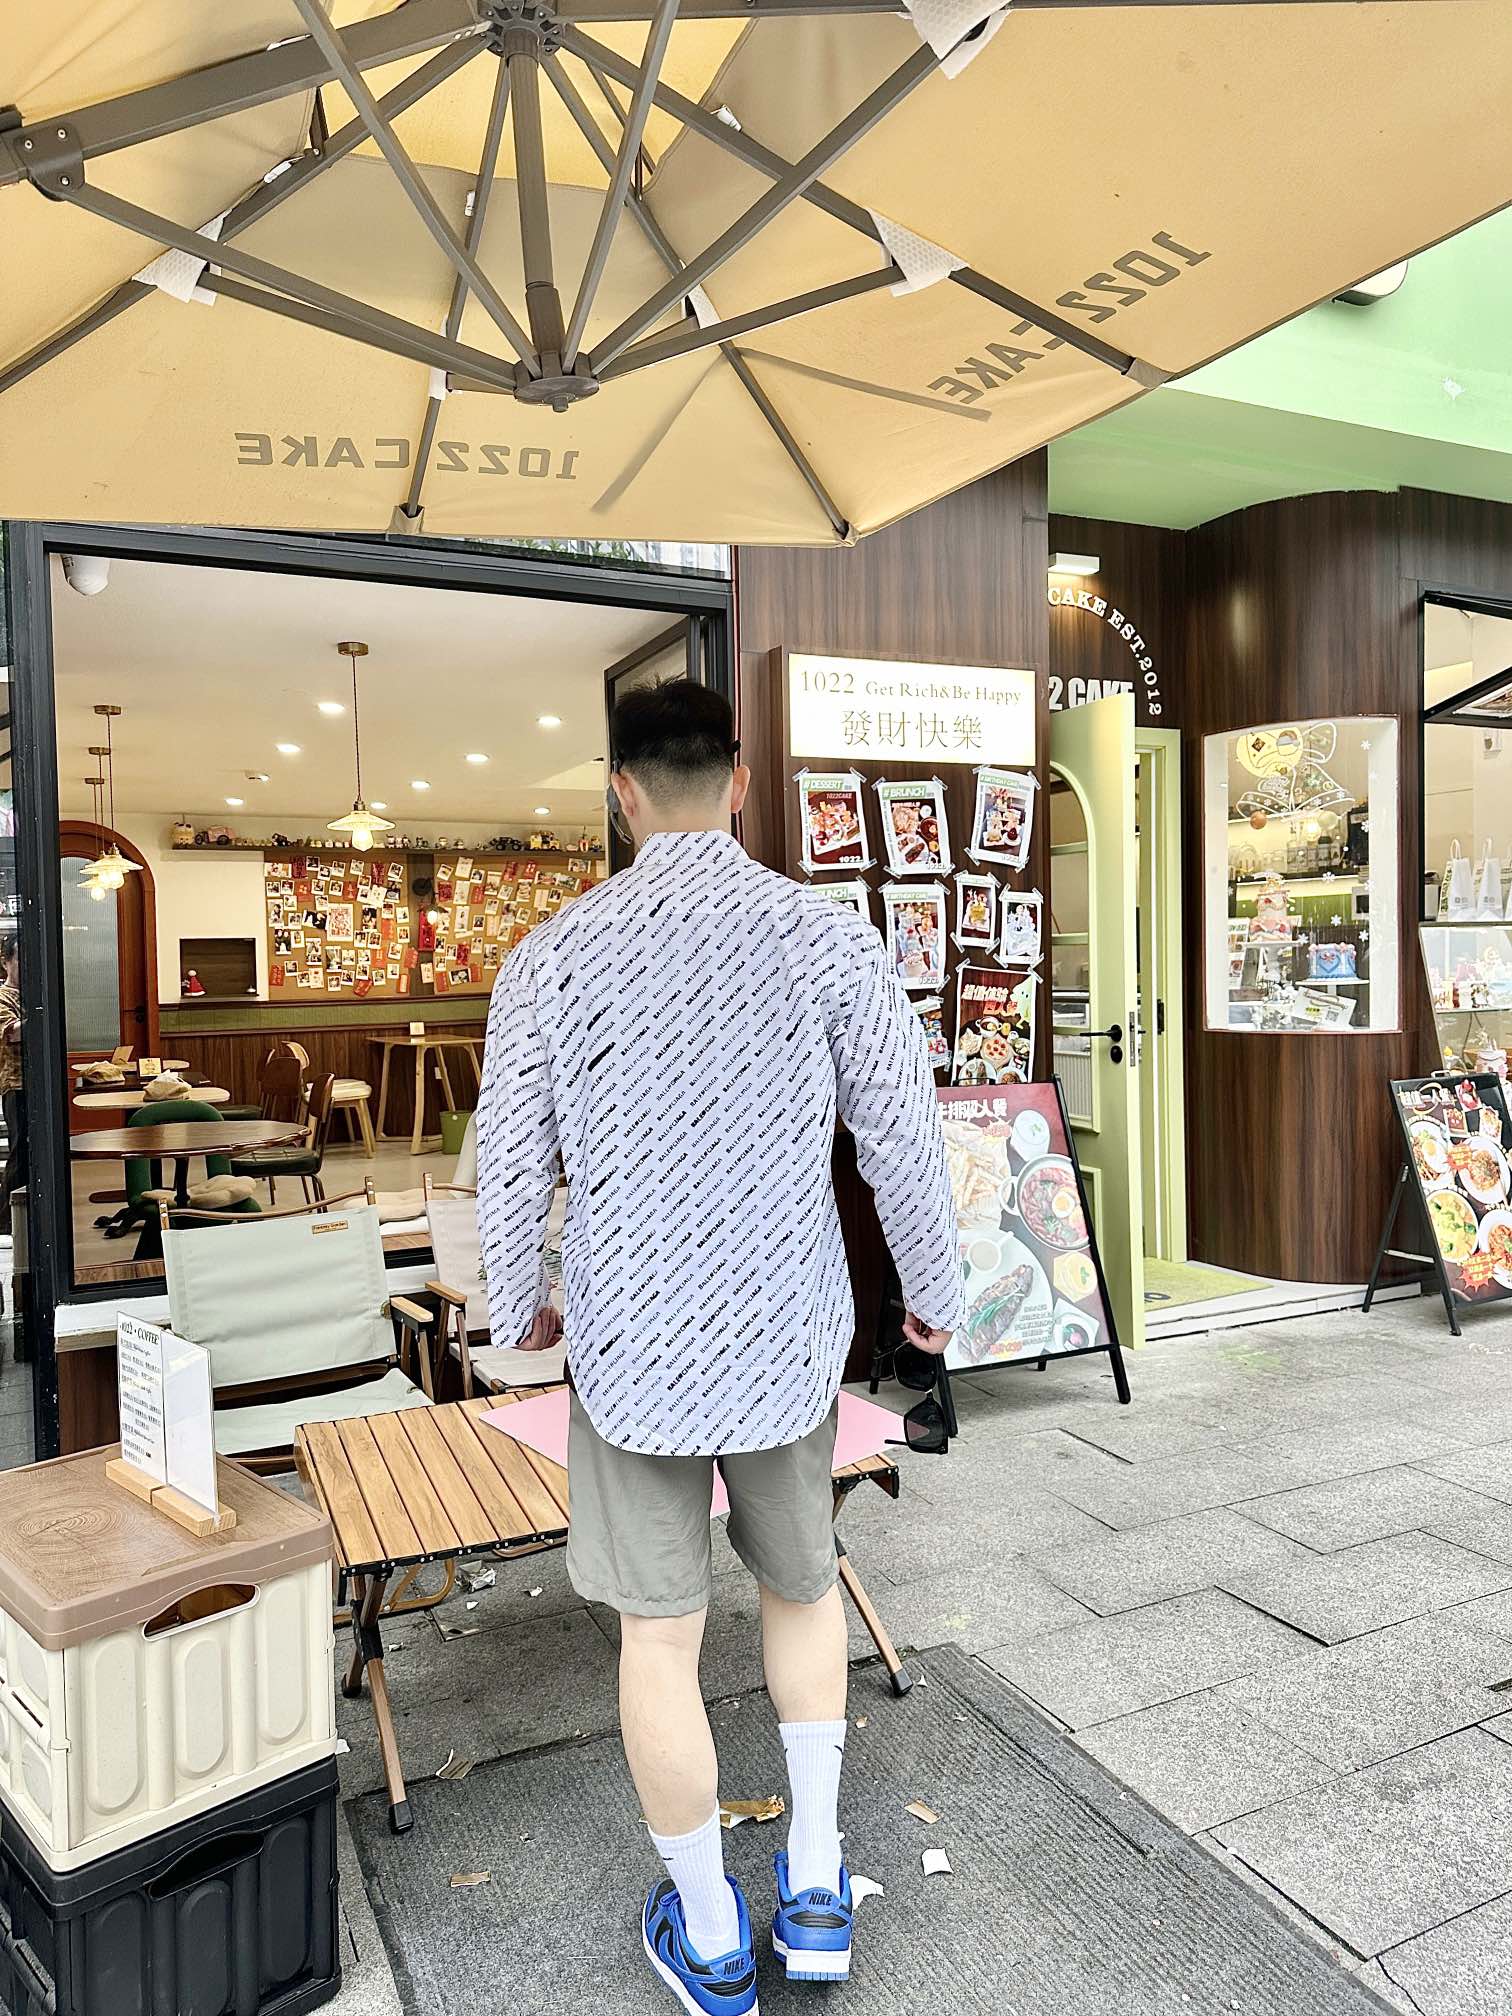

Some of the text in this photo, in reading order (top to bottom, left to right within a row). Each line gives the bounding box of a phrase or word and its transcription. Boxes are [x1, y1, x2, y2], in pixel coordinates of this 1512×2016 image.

[1047, 588, 1108, 618] CAKE
[801, 671, 855, 694] 1022
[865, 680, 894, 696] Get
[975, 687, 1022, 705] Happy
[841, 710, 983, 750] 發財快樂
[882, 787, 925, 798] #BRUNCH
[808, 1892, 833, 1906] NIKE
[723, 1957, 745, 1977] NIKE
